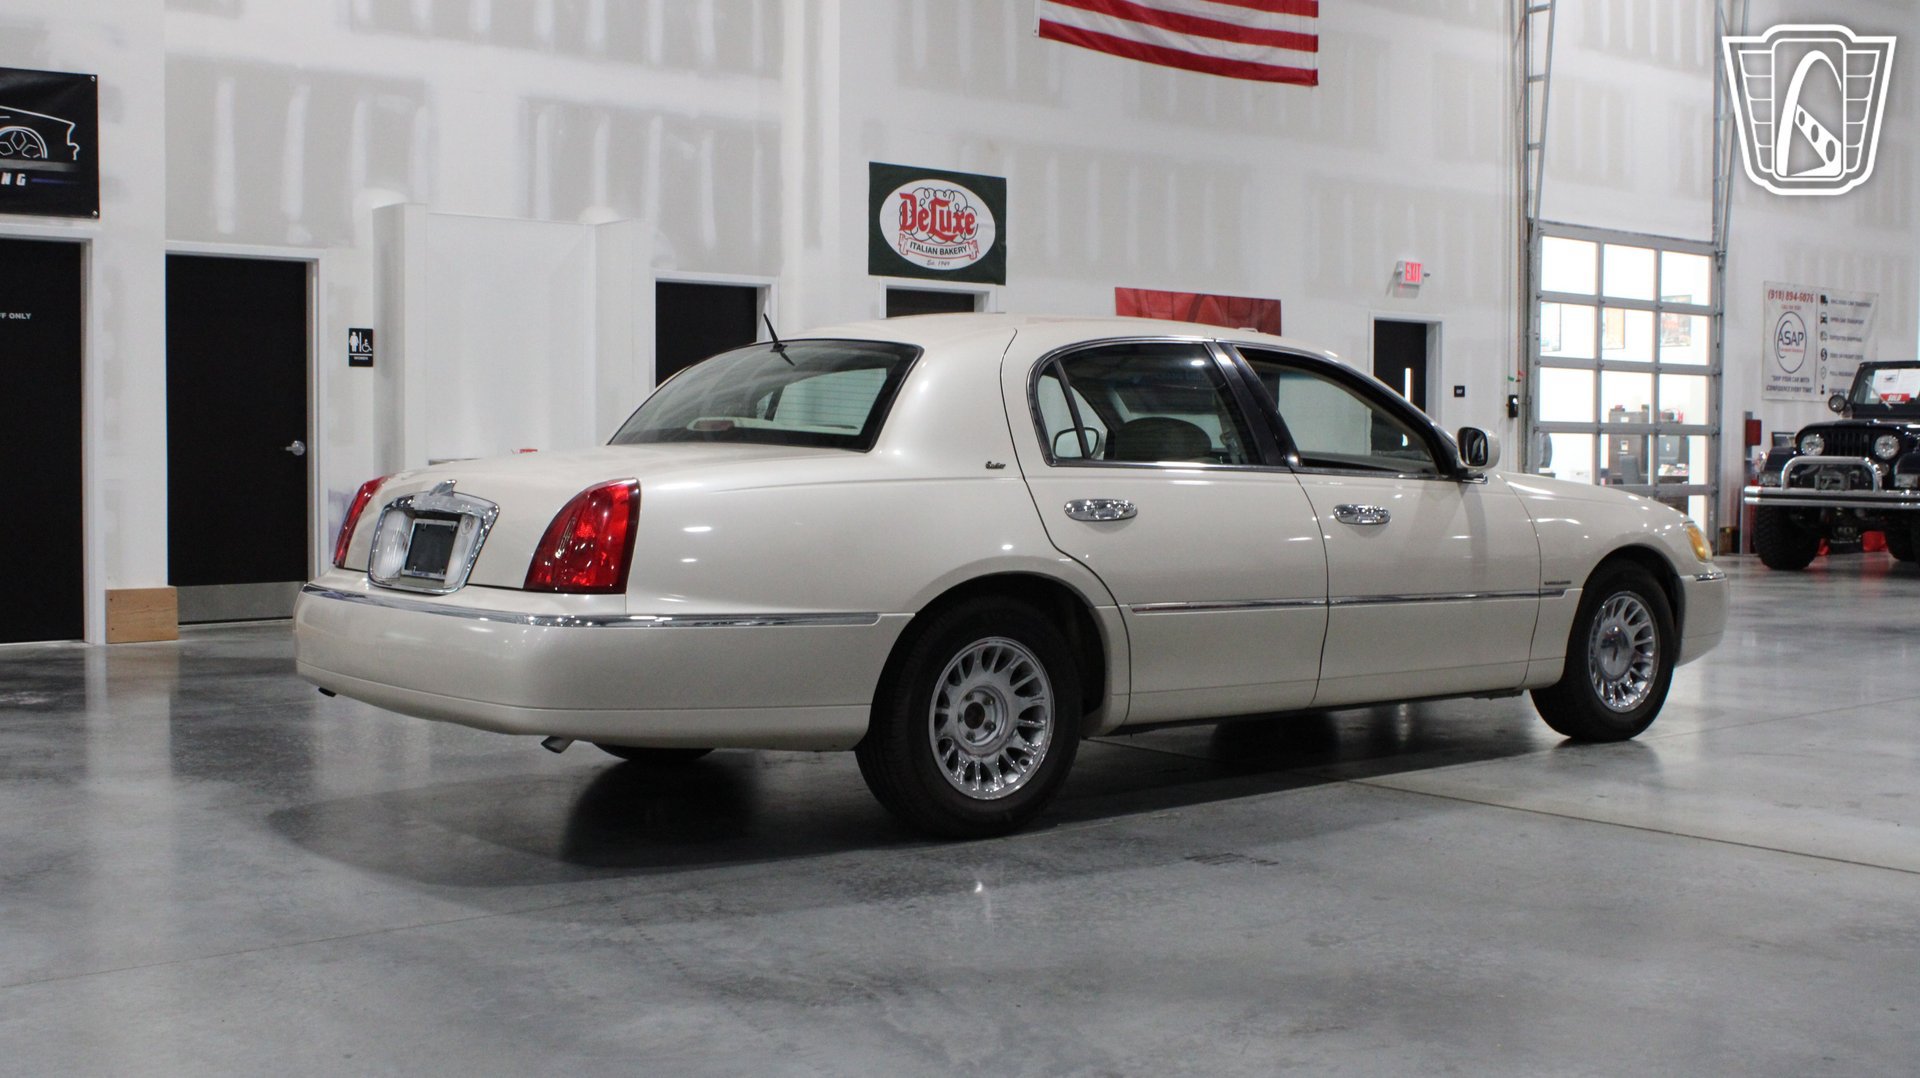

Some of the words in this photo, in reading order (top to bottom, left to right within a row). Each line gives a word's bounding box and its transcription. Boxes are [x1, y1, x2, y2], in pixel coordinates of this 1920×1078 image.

[899, 192, 975, 241] DeLuxe
[909, 241, 938, 255] ITALIAN
[939, 245, 967, 255] BAKERY
[1405, 262, 1421, 282] EXIT
[8, 312, 32, 320] ONLY
[1778, 331, 1805, 347] ASAP
